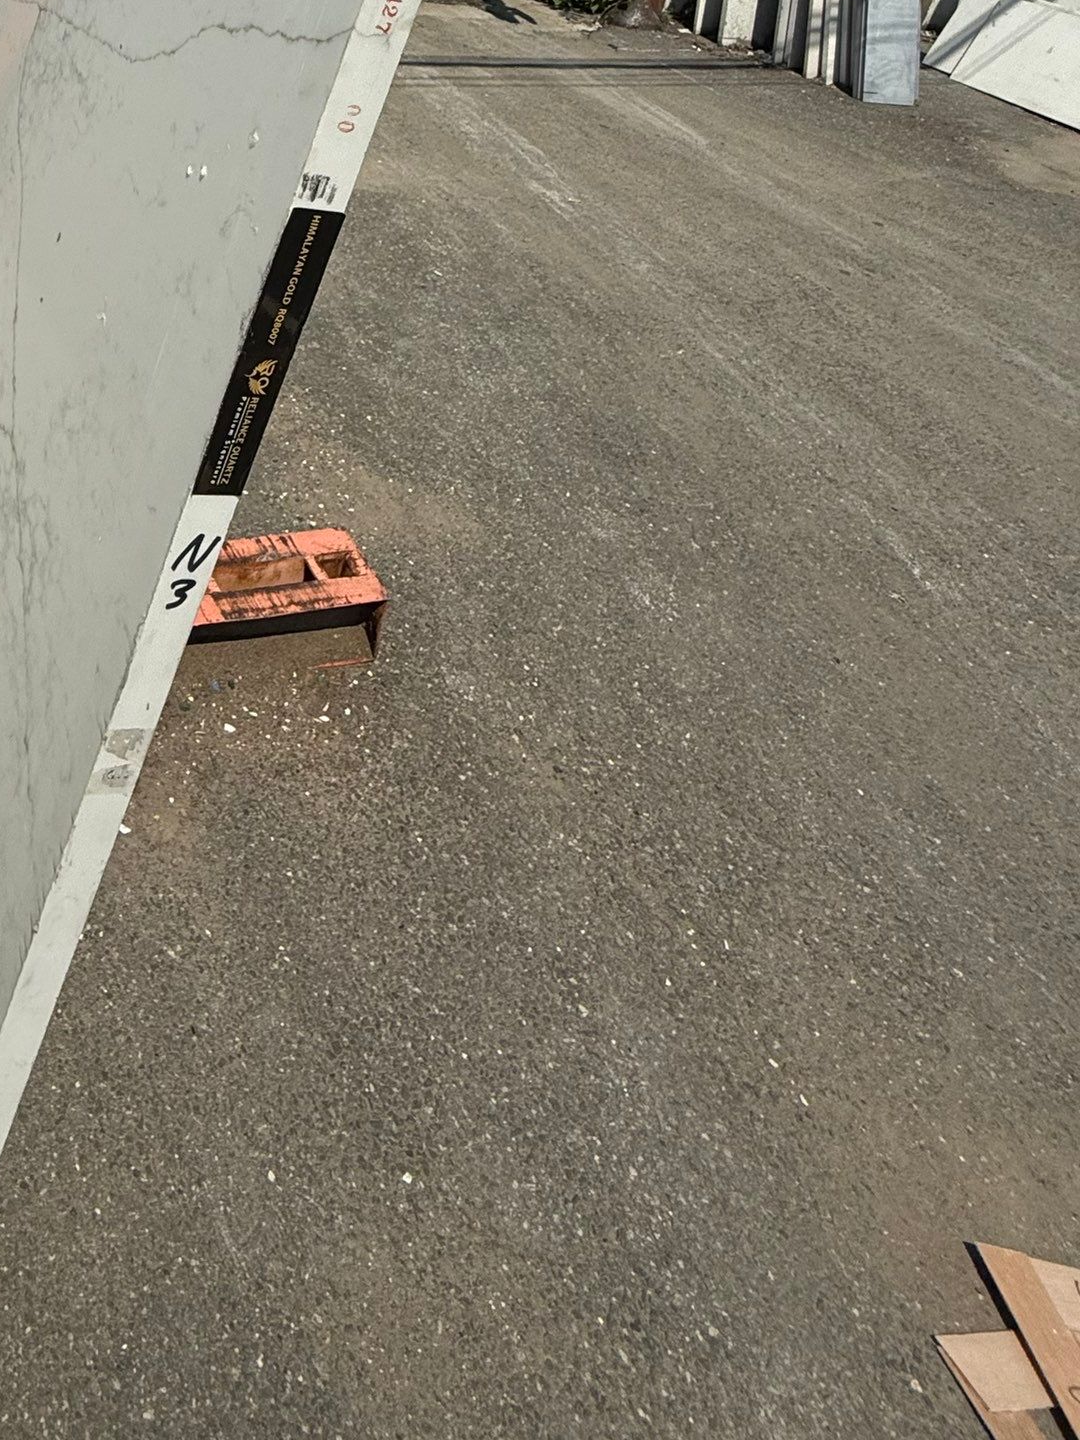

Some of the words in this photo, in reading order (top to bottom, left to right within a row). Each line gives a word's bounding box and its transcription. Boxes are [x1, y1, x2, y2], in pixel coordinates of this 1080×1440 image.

[292, 214, 322, 276] HIMALAYAN
[281, 276, 299, 306] GOLD
[266, 307, 288, 346] RQ8007
[227, 395, 248, 437] Premium
[235, 396, 260, 445] RELIANCE
[209, 439, 233, 486] Signature
[220, 446, 242, 486] QUARTZ
